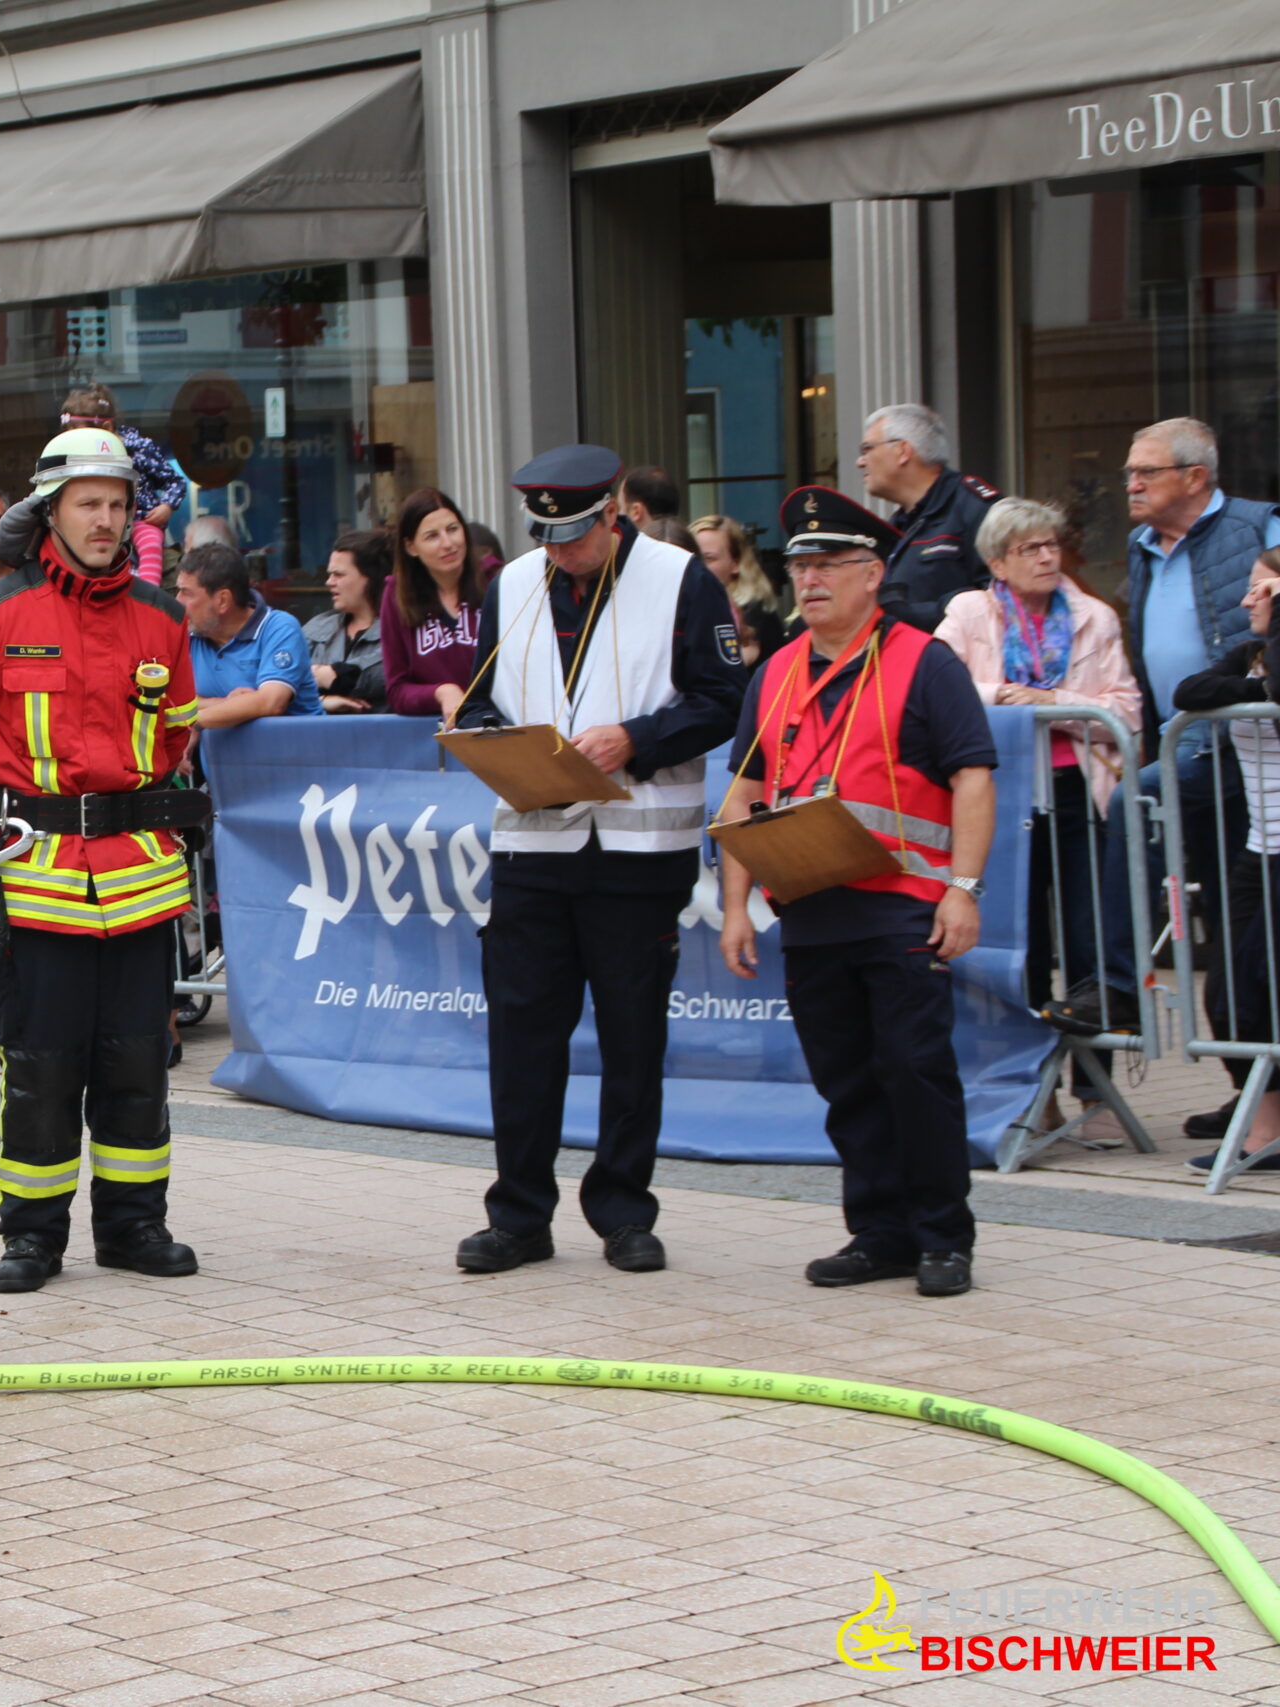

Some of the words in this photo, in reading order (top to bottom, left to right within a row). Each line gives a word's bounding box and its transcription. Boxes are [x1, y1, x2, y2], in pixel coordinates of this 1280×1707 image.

[101, 440, 110, 452] A
[315, 980, 357, 1007] Die
[40, 1370, 172, 1384] Bischweier
[200, 1366, 279, 1380] PARSCH
[294, 1362, 413, 1377] SYNTHETIC
[466, 1362, 543, 1377] REFLEX
[646, 1369, 702, 1385] 14811
[727, 1375, 774, 1391] 3/18
